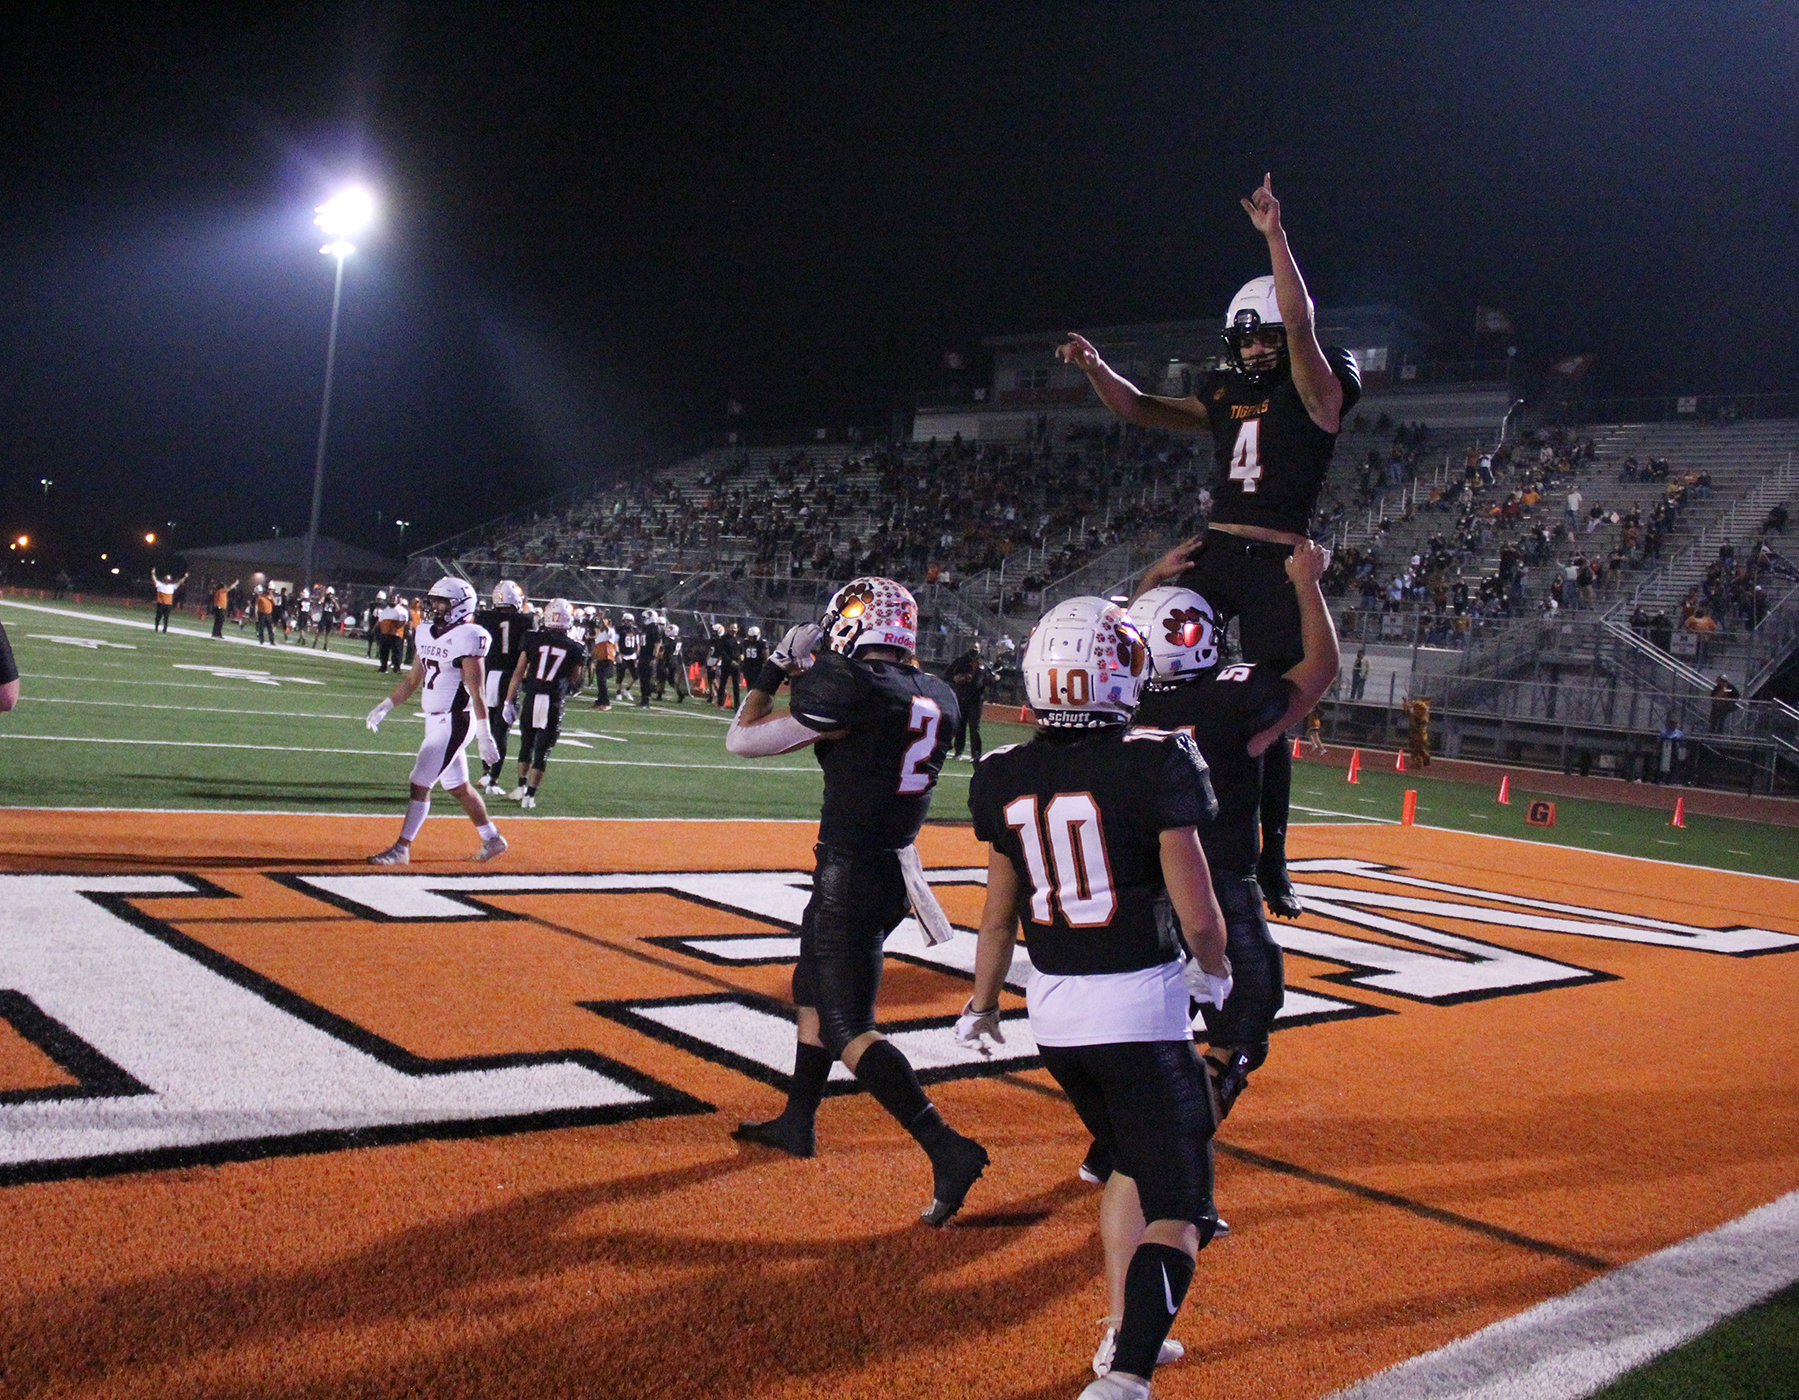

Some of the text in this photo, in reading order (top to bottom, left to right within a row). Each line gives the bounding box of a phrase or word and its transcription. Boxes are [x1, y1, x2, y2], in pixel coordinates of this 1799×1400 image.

[1229, 420, 1263, 493] 4
[421, 644, 449, 658] TIGERS
[500, 620, 510, 654] 1
[536, 645, 567, 681] 17
[1048, 668, 1089, 706] 10
[897, 695, 942, 795] 2
[1531, 803, 1549, 822] G
[1003, 791, 1118, 928] 10
